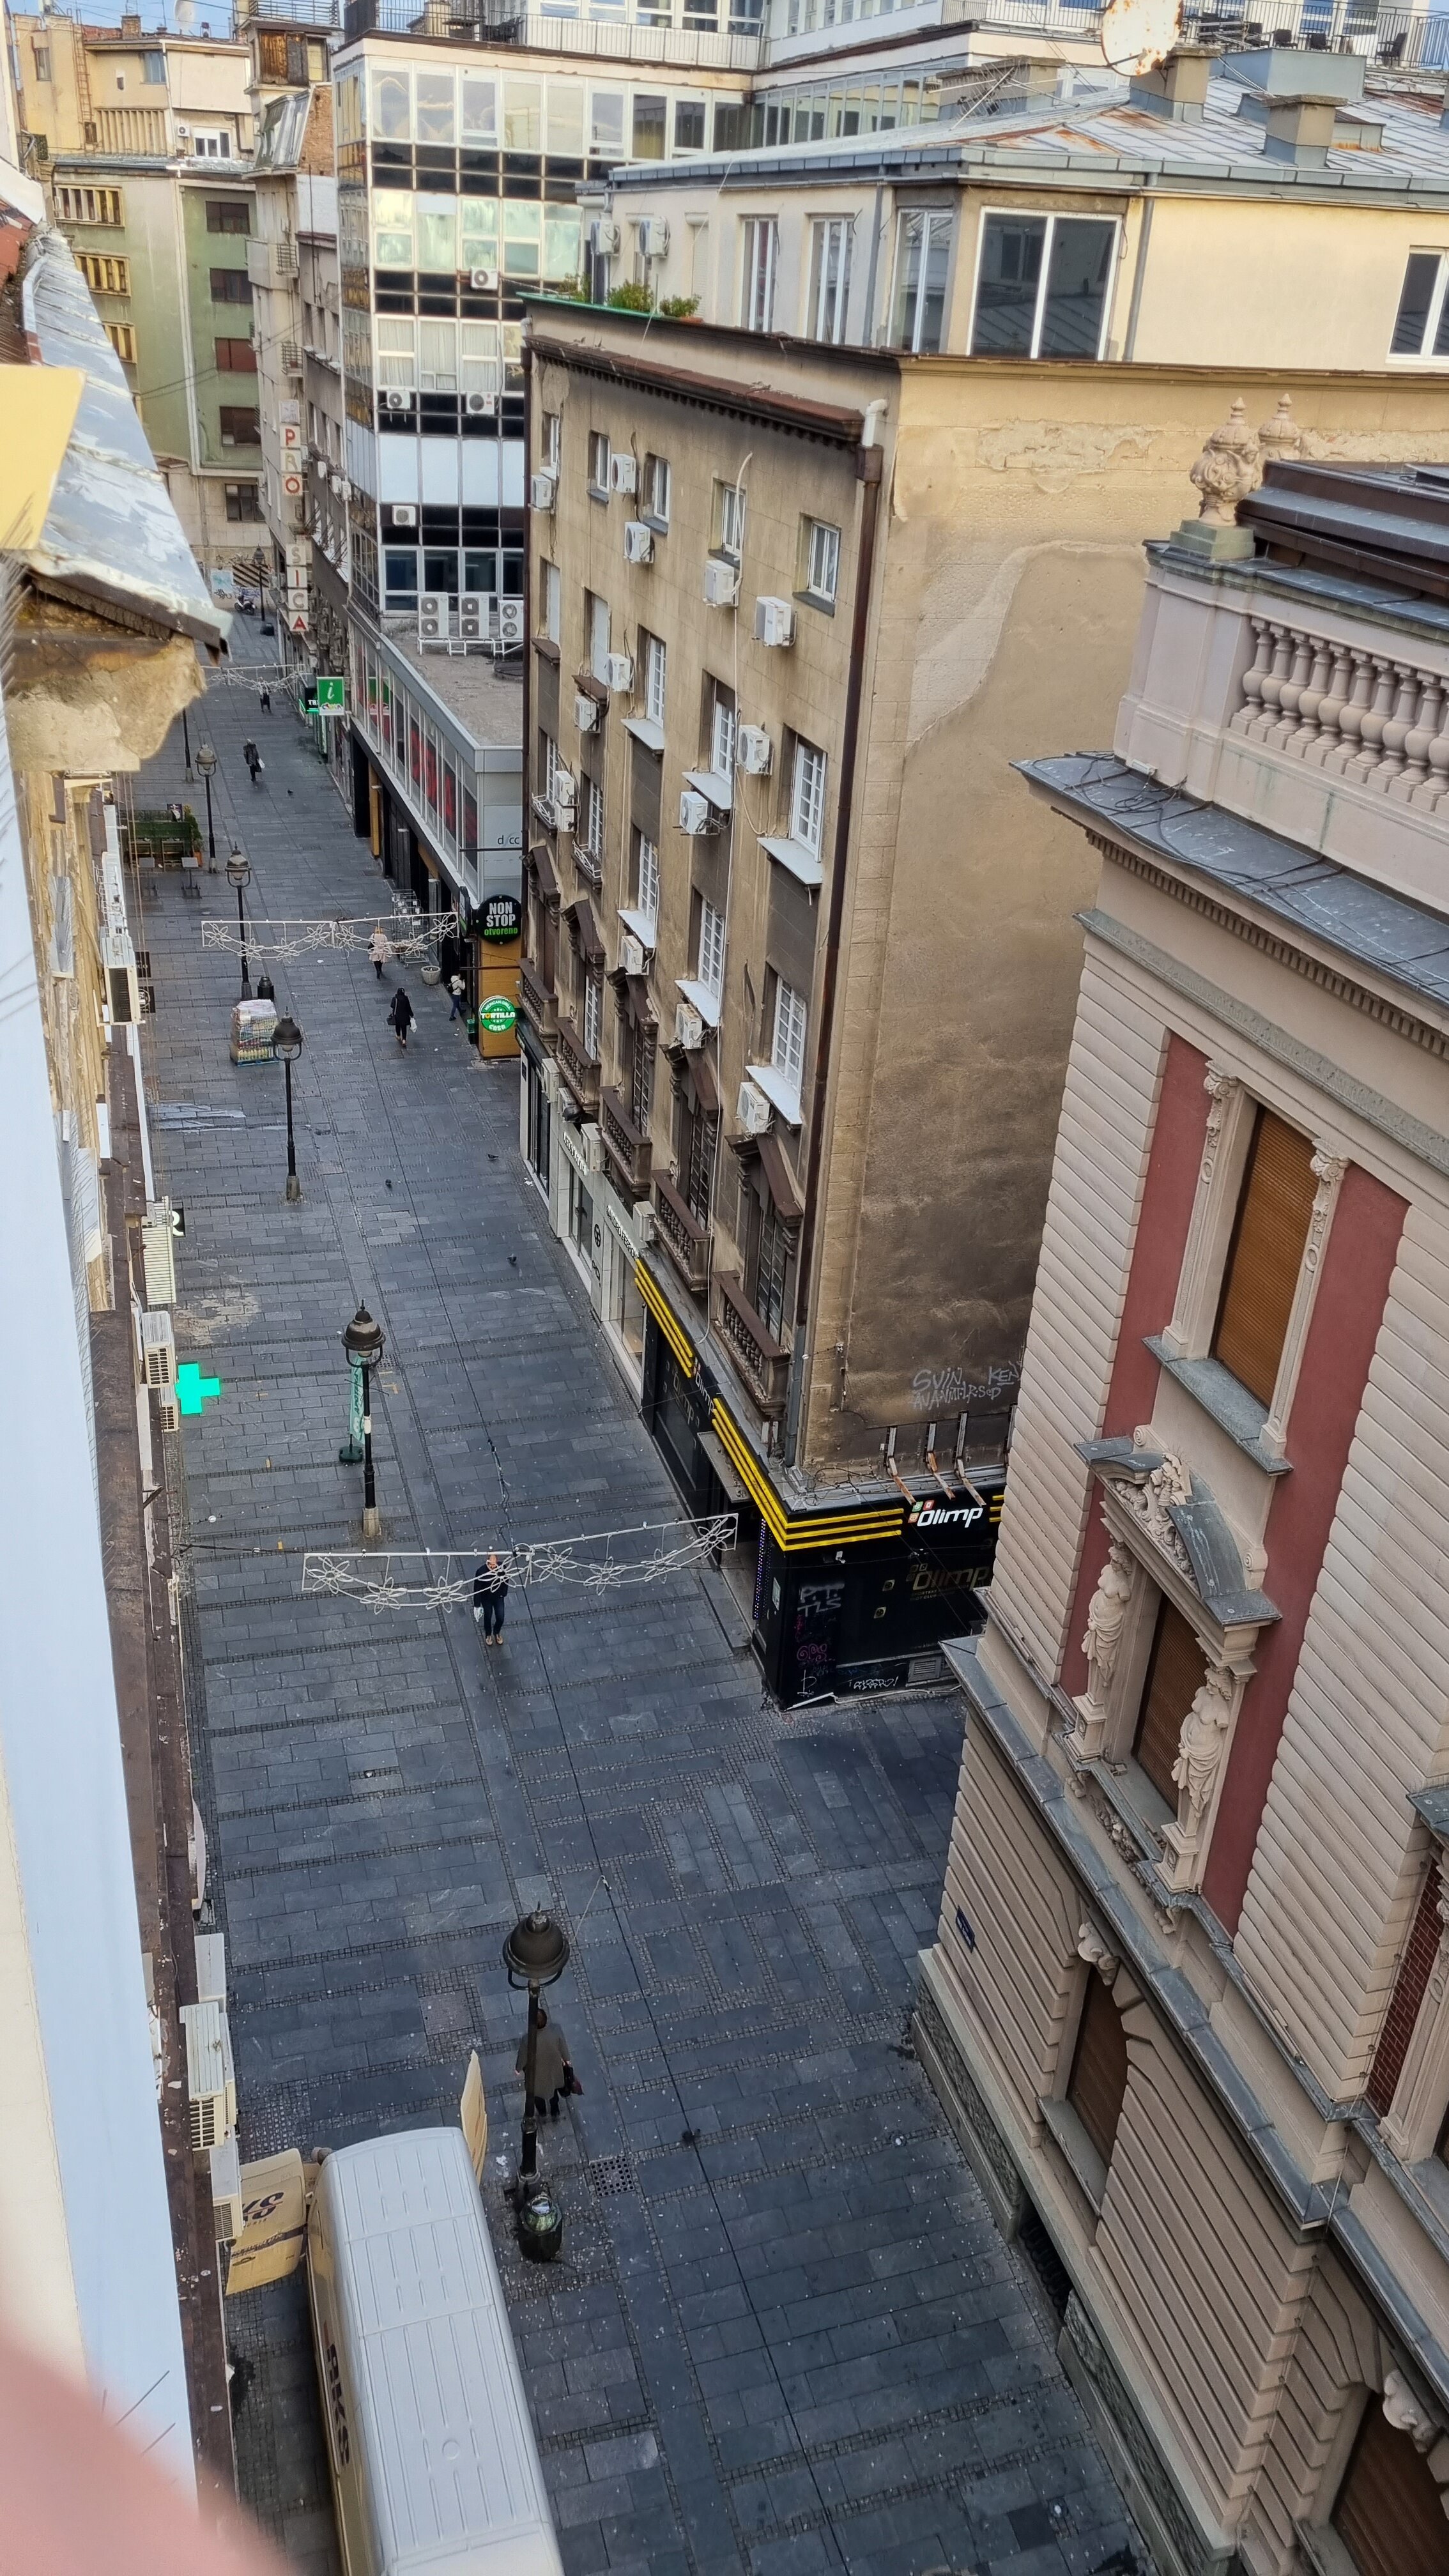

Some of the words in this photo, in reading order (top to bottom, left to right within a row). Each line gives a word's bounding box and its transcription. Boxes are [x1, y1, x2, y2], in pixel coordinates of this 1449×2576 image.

[489, 901, 513, 915] NON
[486, 914, 516, 927] STOP
[484, 927, 518, 936] otvoreno
[695, 1372, 714, 1416] Olimp
[917, 1507, 983, 1528] Olimp
[241, 2191, 284, 2223] KS
